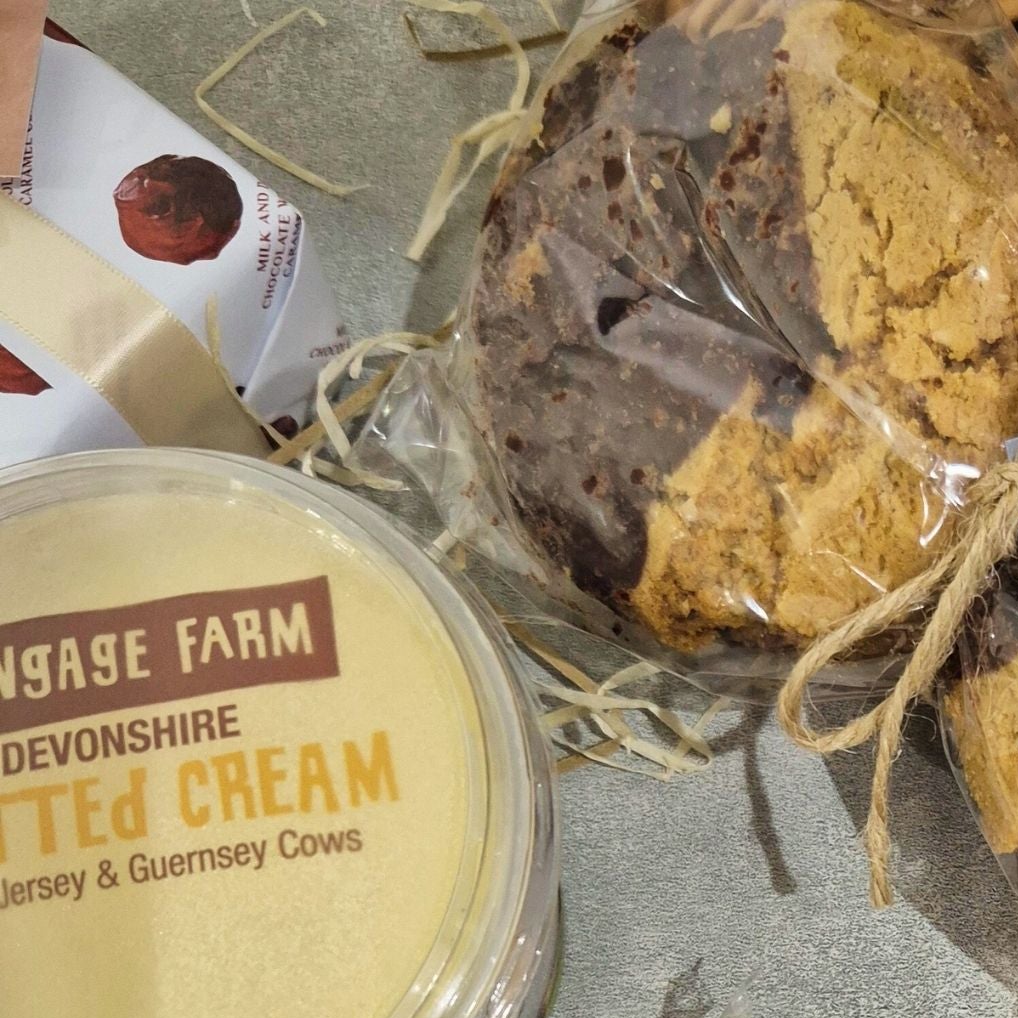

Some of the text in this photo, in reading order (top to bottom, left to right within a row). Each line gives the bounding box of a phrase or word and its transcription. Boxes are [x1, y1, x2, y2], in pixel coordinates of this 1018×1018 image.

[257, 192, 271, 224] AND
[256, 232, 272, 272] MILK
[262, 215, 292, 309] CHOCOLATE
[176, 603, 314, 674] FARM
[2, 704, 242, 777] DEVONSHIRE
[178, 730, 401, 829] CREAM
[97, 859, 120, 890] &
[129, 838, 268, 884] Guernsey
[278, 828, 364, 859] Cows
